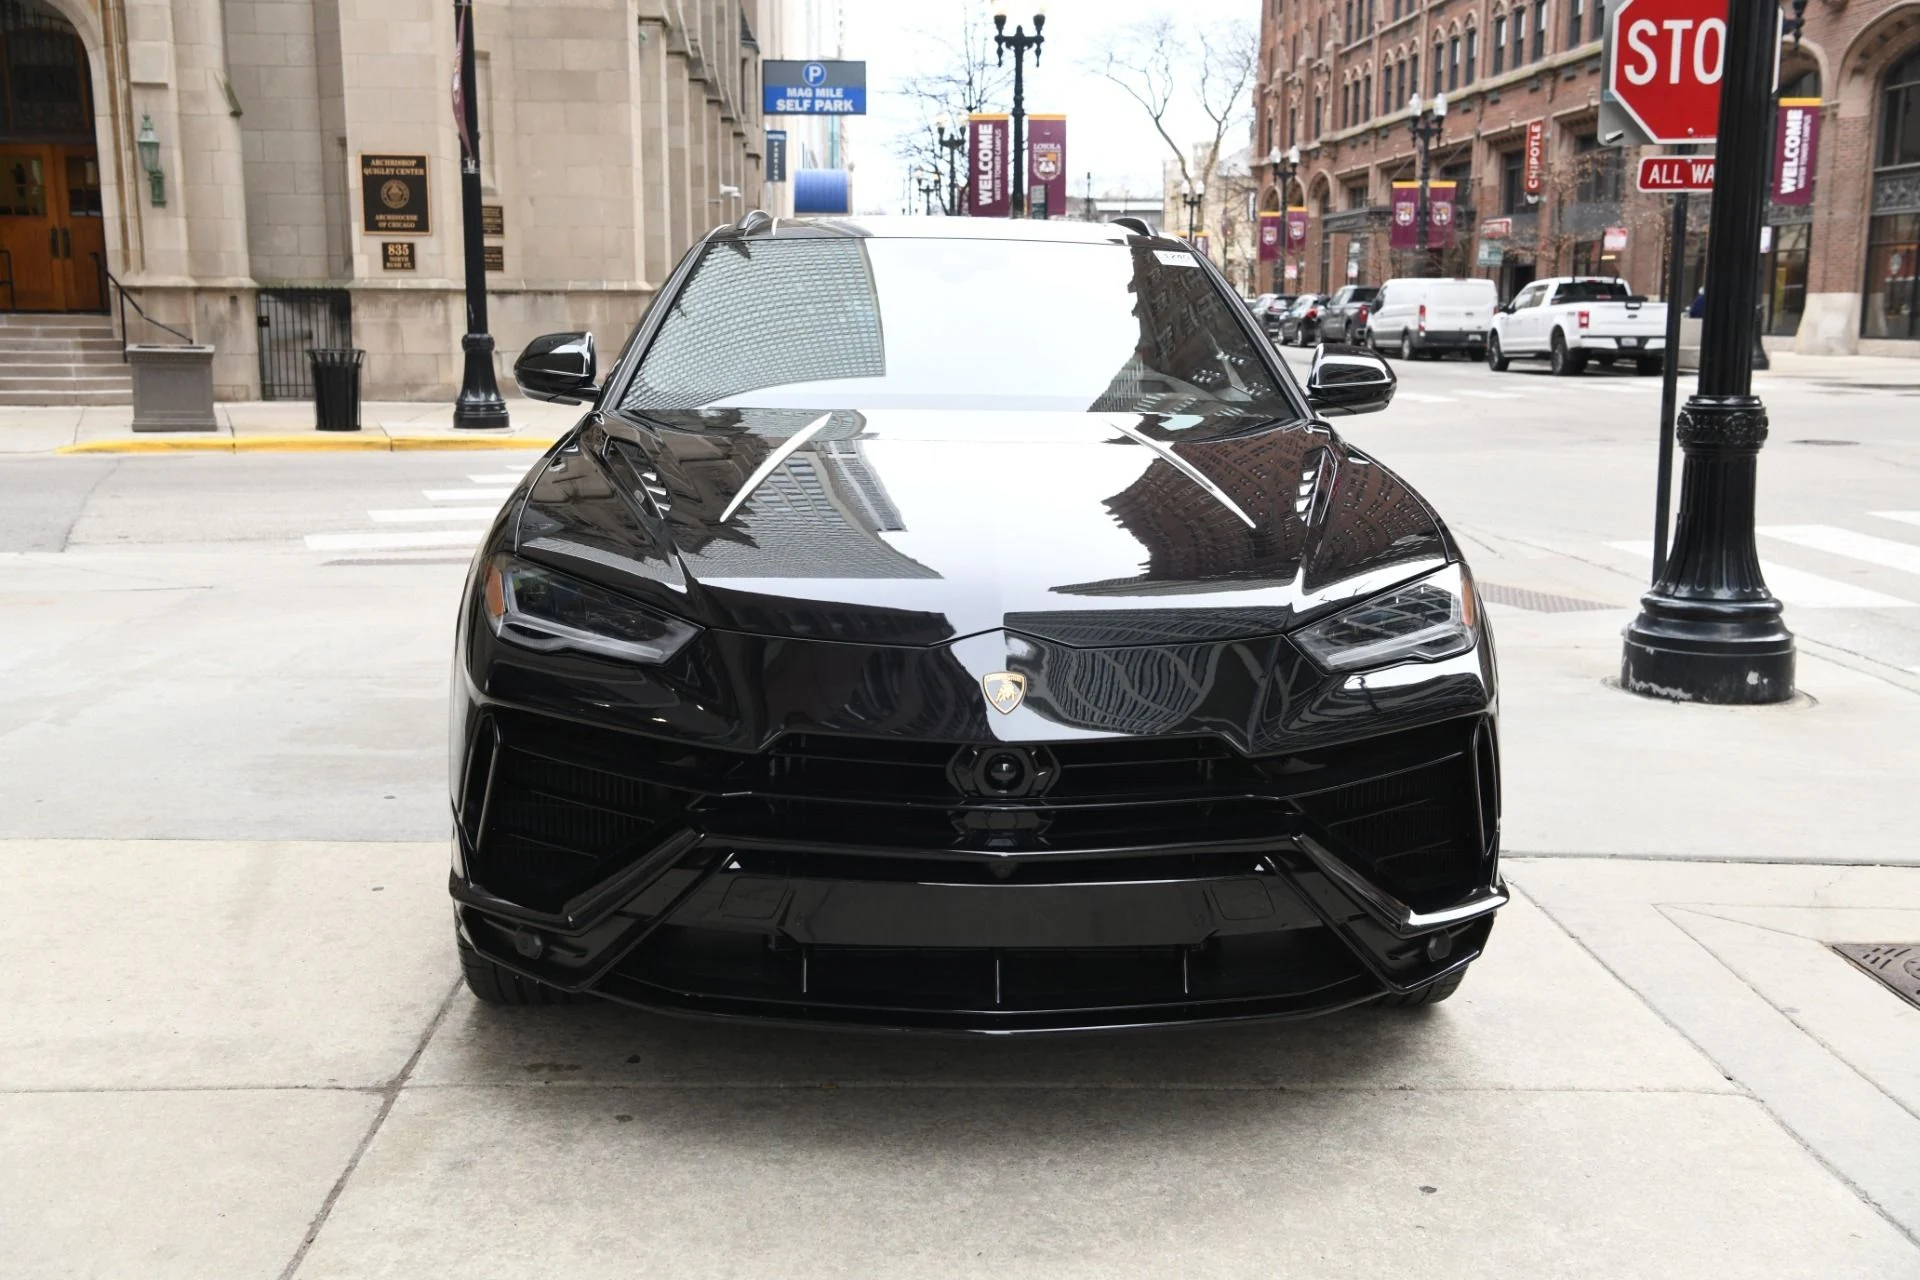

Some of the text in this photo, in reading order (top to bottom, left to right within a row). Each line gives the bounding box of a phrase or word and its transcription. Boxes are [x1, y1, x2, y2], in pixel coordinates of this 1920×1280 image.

[1624, 18, 1726, 85] STO
[809, 66, 821, 82] P
[787, 88, 843, 98] MAG MILE
[776, 99, 853, 111] SELF PARK
[1529, 124, 1542, 189] CHIPOTLE
[1780, 109, 1803, 194] WELCOME
[363, 167, 424, 176] QUIGLEY CENTER
[978, 123, 994, 206] WELCOME
[994, 129, 1002, 201] WATER TOWER CAMPUS
[1648, 164, 1715, 184] ALL WA
[388, 244, 409, 256] 835
